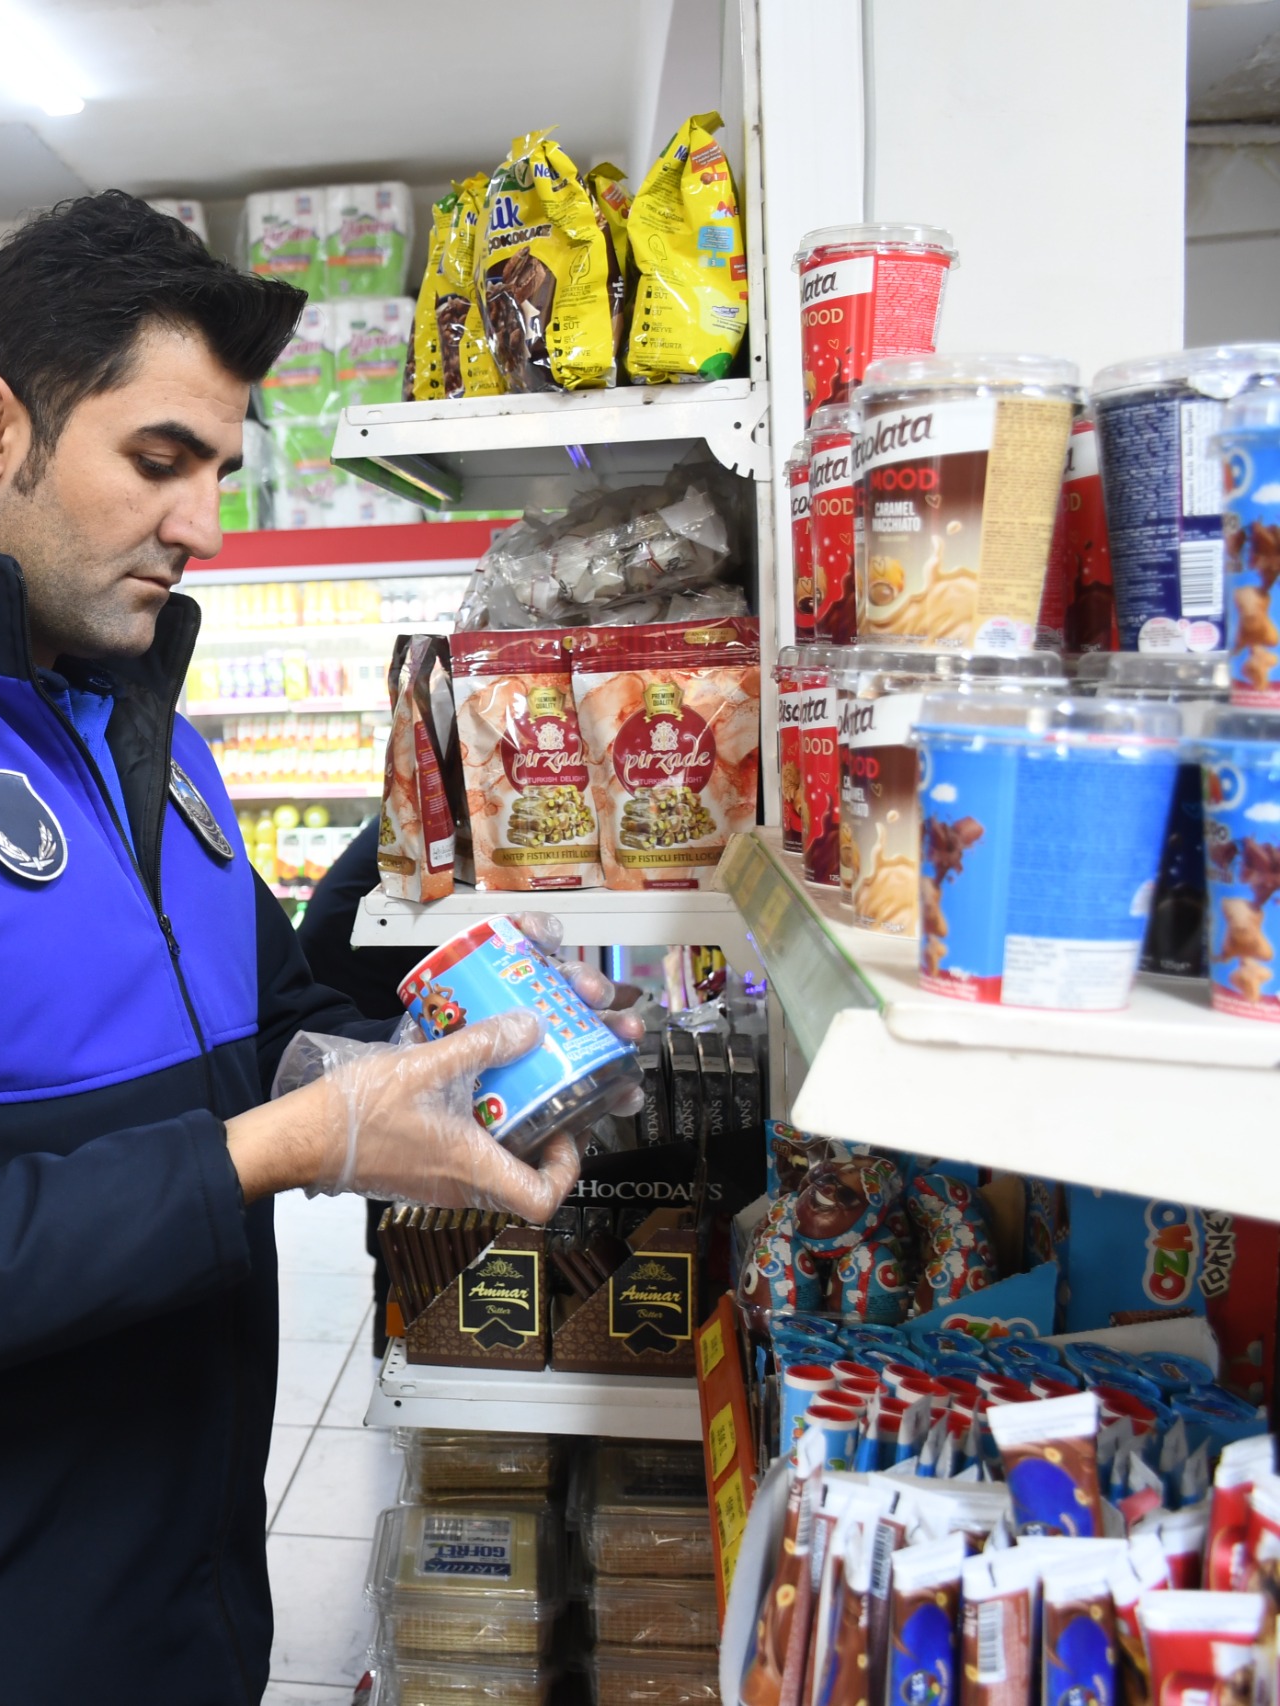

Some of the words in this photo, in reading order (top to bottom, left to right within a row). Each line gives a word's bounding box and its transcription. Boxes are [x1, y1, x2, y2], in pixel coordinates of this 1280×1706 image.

[801, 272, 838, 303] lata
[810, 455, 850, 490] lata
[651, 692, 675, 700] PREMIUM
[652, 699, 675, 707] QUALITY
[513, 734, 588, 785] pirzad
[623, 734, 711, 786] pirzade
[469, 1281, 529, 1299] Ammar
[620, 1285, 681, 1302] Ammar
[485, 1304, 511, 1315] Bitter
[636, 1308, 663, 1319] Bitter
[435, 1545, 505, 1558] GOFRET
